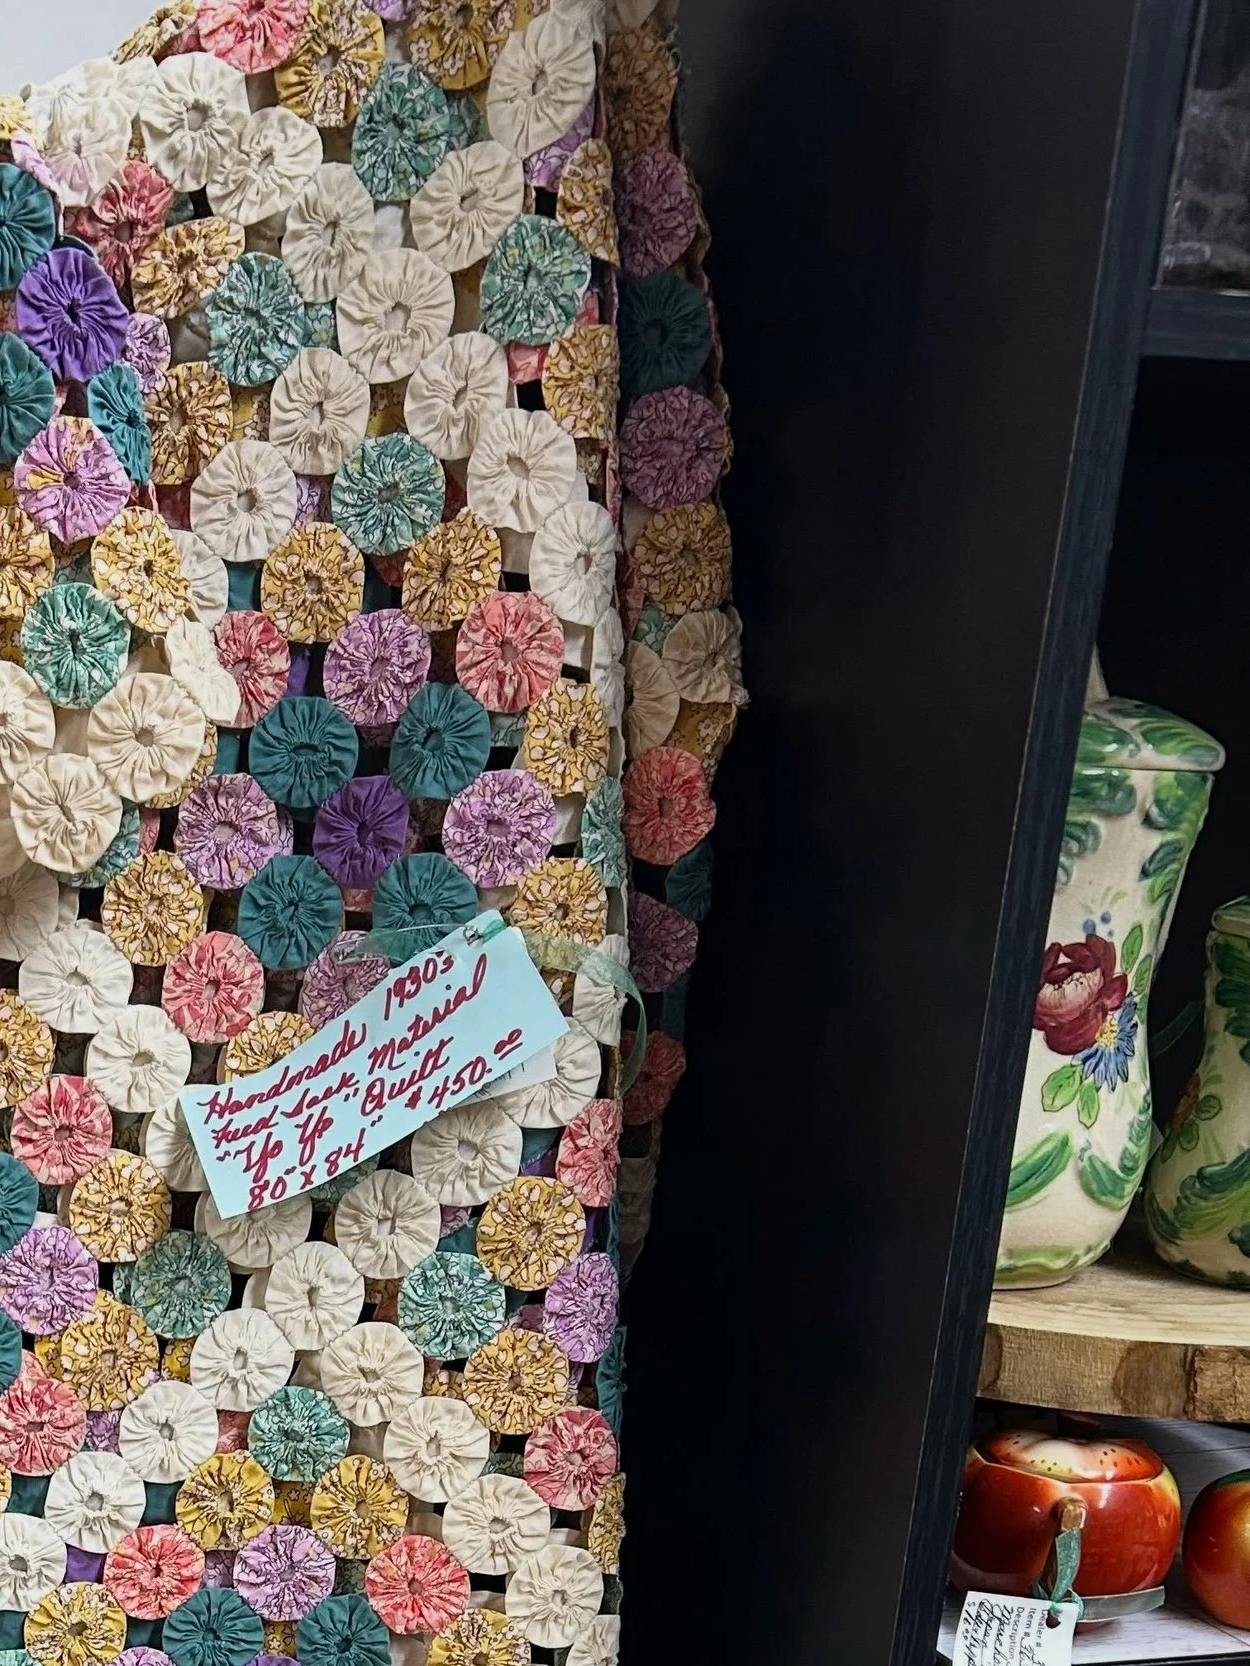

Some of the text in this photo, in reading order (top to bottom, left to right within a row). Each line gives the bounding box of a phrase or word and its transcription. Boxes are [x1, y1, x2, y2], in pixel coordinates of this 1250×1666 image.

[197, 949, 455, 1124] Handmade 1930's
[211, 953, 488, 1149] Feed Sack Material
[360, 1036, 454, 1117] Quilt
[1009, 1606, 1025, 1660] Description
[1025, 1607, 1037, 1629] Item
